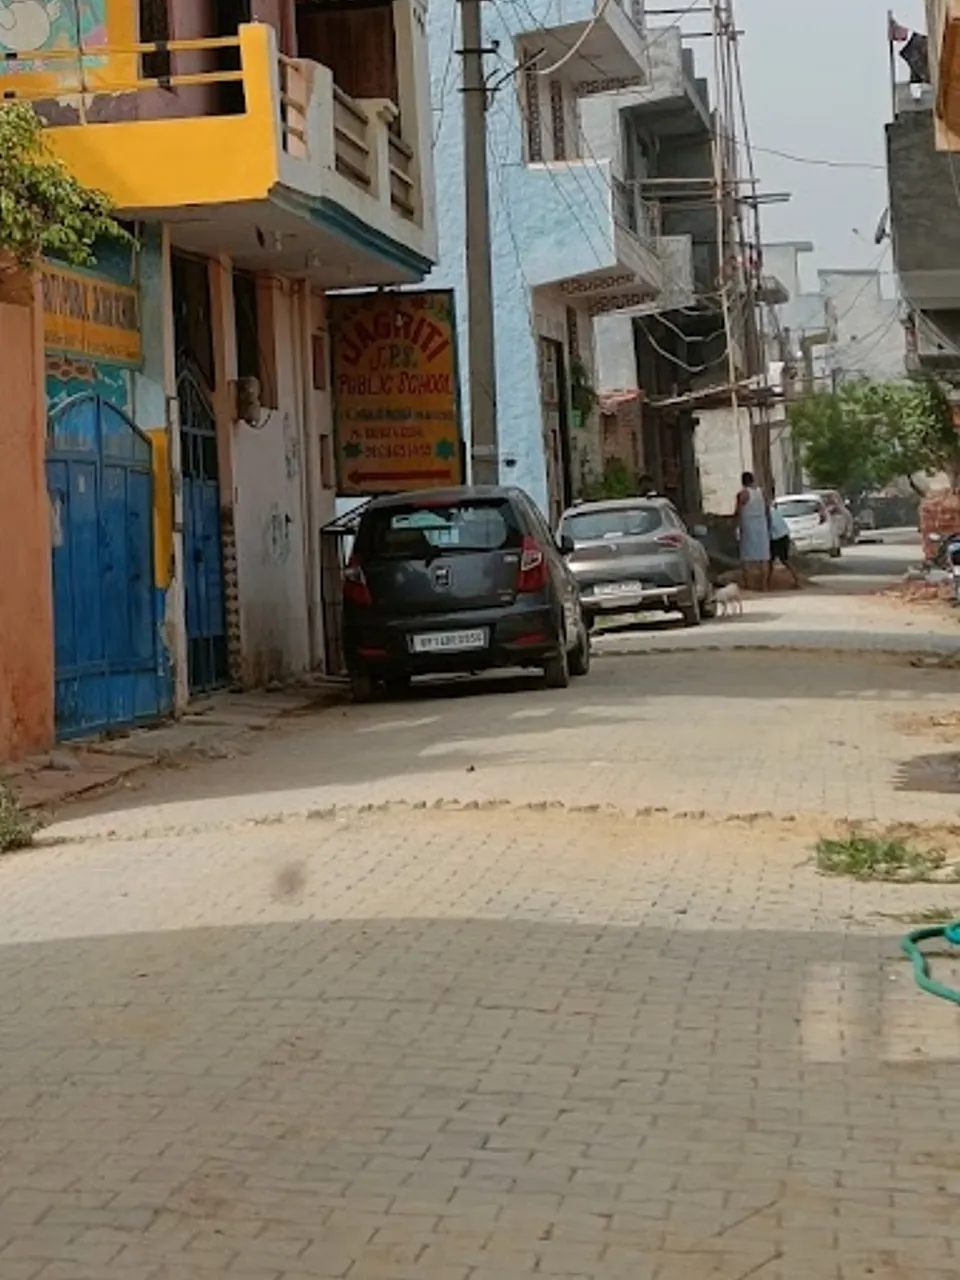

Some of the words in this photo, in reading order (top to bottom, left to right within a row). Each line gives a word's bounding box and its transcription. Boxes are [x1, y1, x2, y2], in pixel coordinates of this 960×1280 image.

[341, 308, 450, 368] JAGRITI
[338, 372, 393, 396] PUBLIC
[397, 370, 452, 396] SCHOOL
